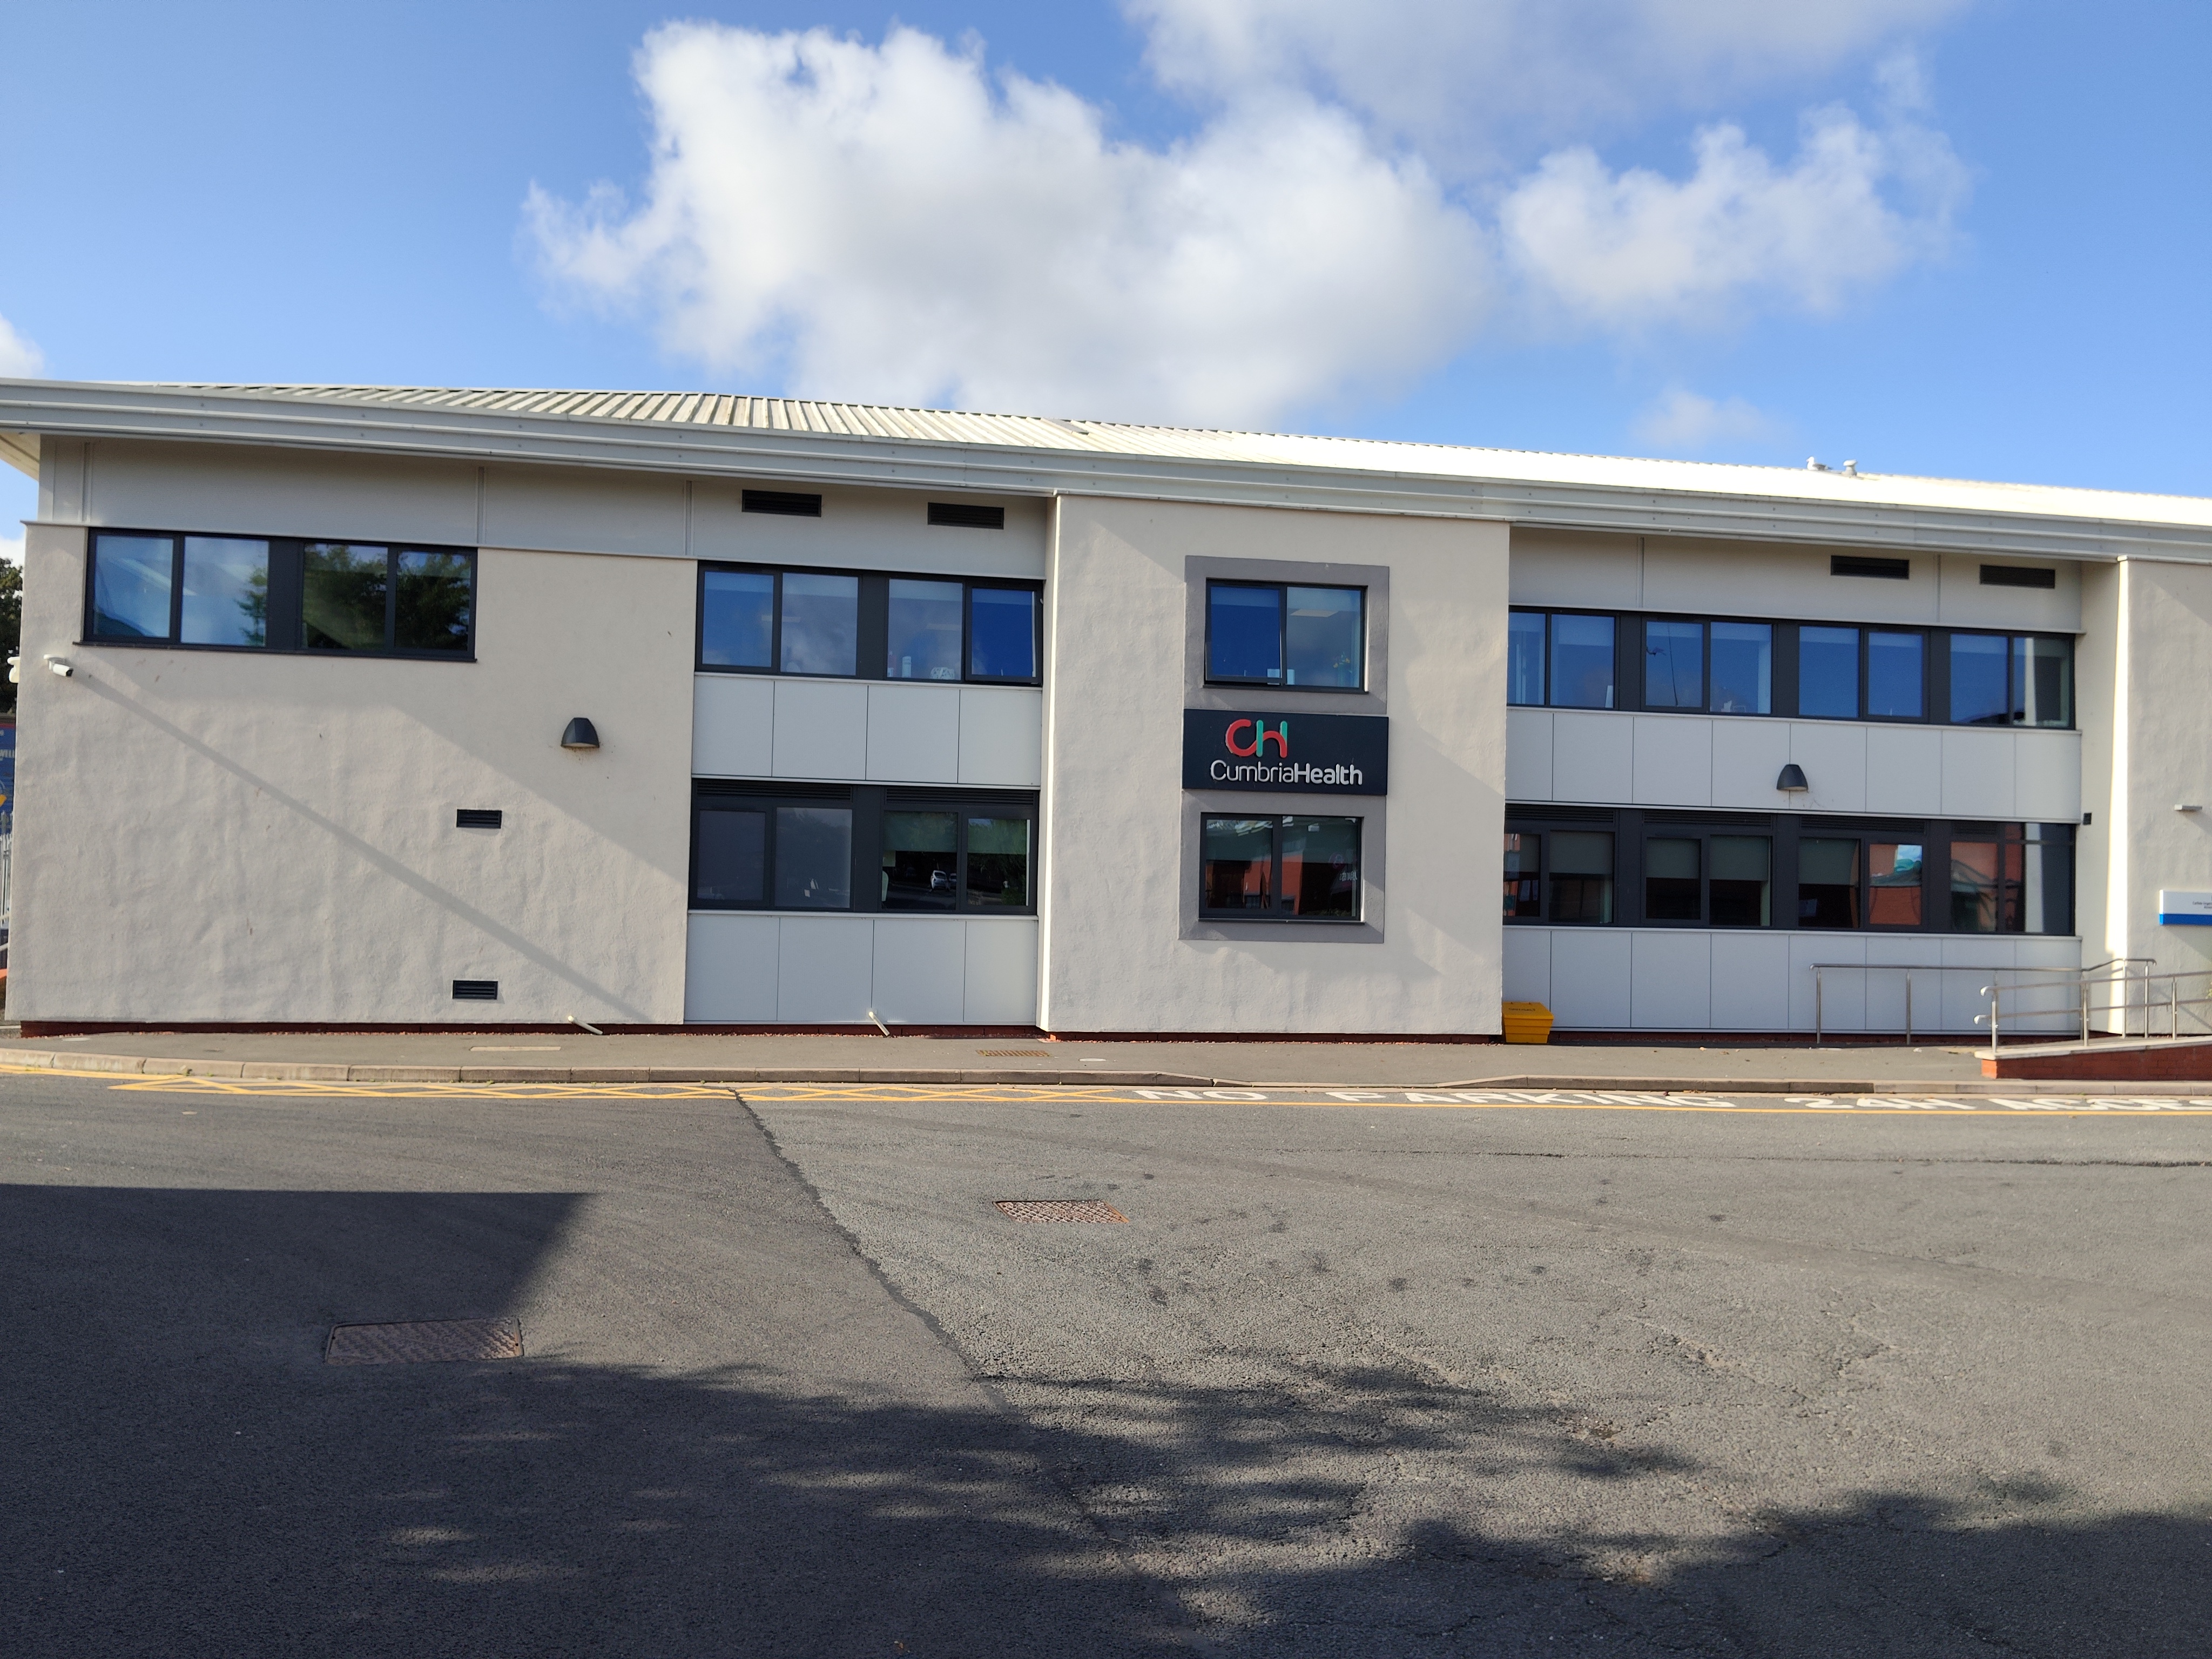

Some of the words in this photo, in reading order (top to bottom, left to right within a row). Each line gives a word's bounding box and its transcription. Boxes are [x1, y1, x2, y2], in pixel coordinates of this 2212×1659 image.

[1210, 760, 1363, 785] CumbriaHealth
[1133, 1090, 1268, 1101] NO
[1324, 1091, 1737, 1108] PARKING
[1784, 1097, 1978, 1110] 24H
